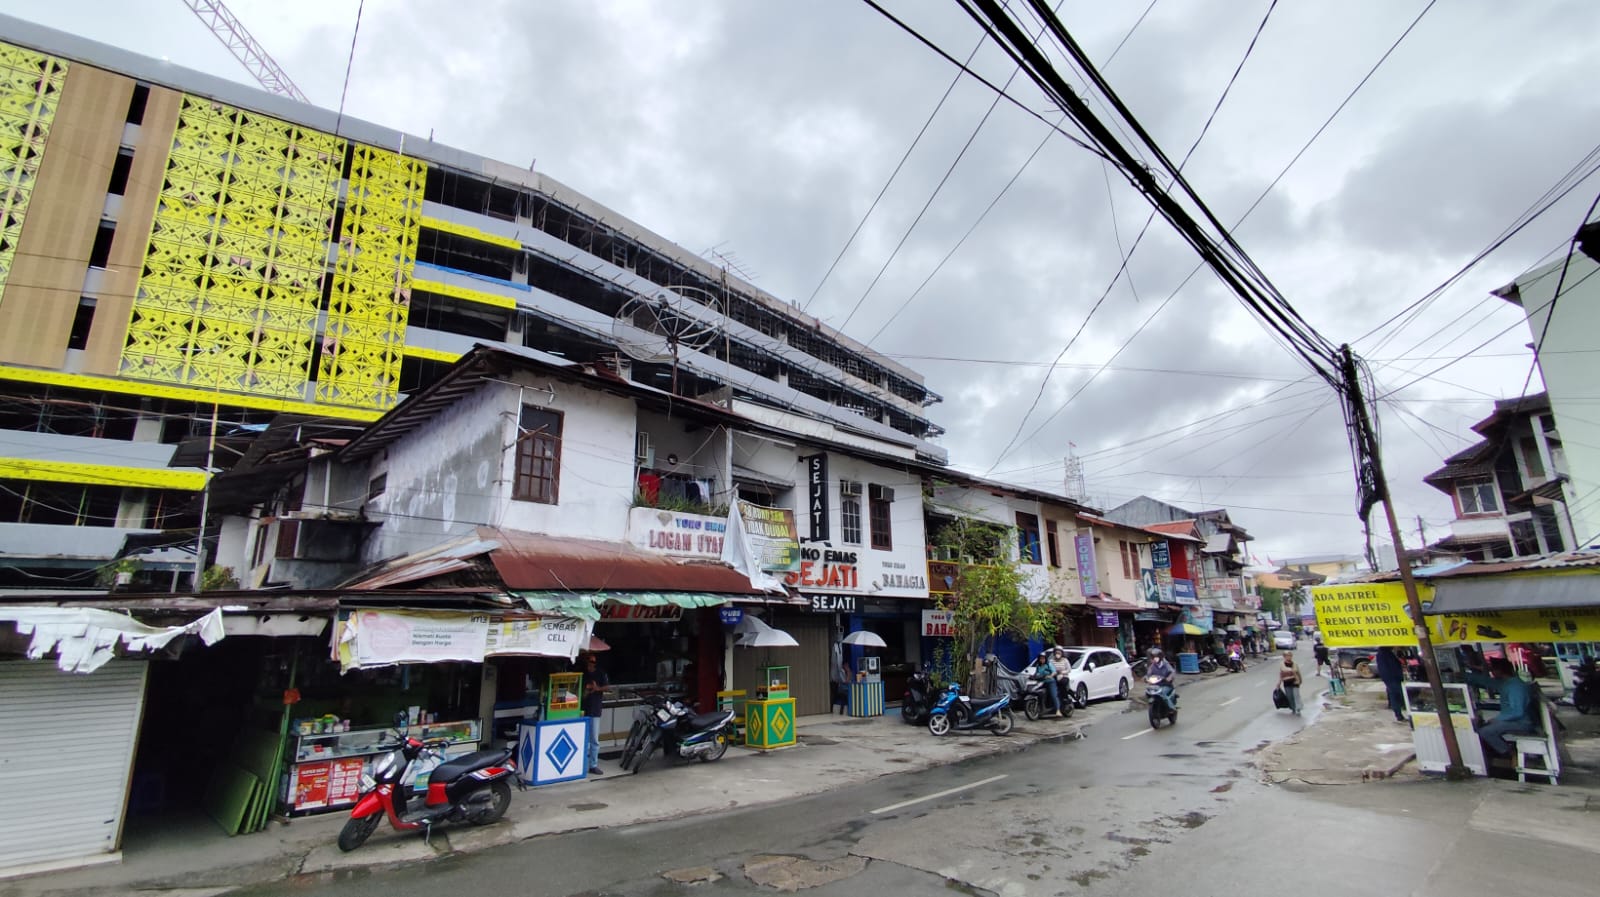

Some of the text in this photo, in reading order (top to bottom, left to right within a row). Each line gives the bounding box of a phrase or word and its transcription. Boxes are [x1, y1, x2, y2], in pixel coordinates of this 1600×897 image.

[813, 458, 822, 538] SEJATI
[649, 529, 692, 551] LOGAM
[824, 550, 858, 564] EMAS
[785, 561, 858, 589] SEJATI
[882, 573, 926, 589] BAHAGIA
[813, 595, 856, 609] SEJATI
[1314, 593, 1335, 602] ADA
[1345, 602, 1391, 613] (SERVIS)
[1325, 614, 1401, 626] REMOT MOBIL
[547, 633, 567, 643] CELL
[1328, 629, 1365, 638] REMOT
[1369, 627, 1409, 638] MOTOR
